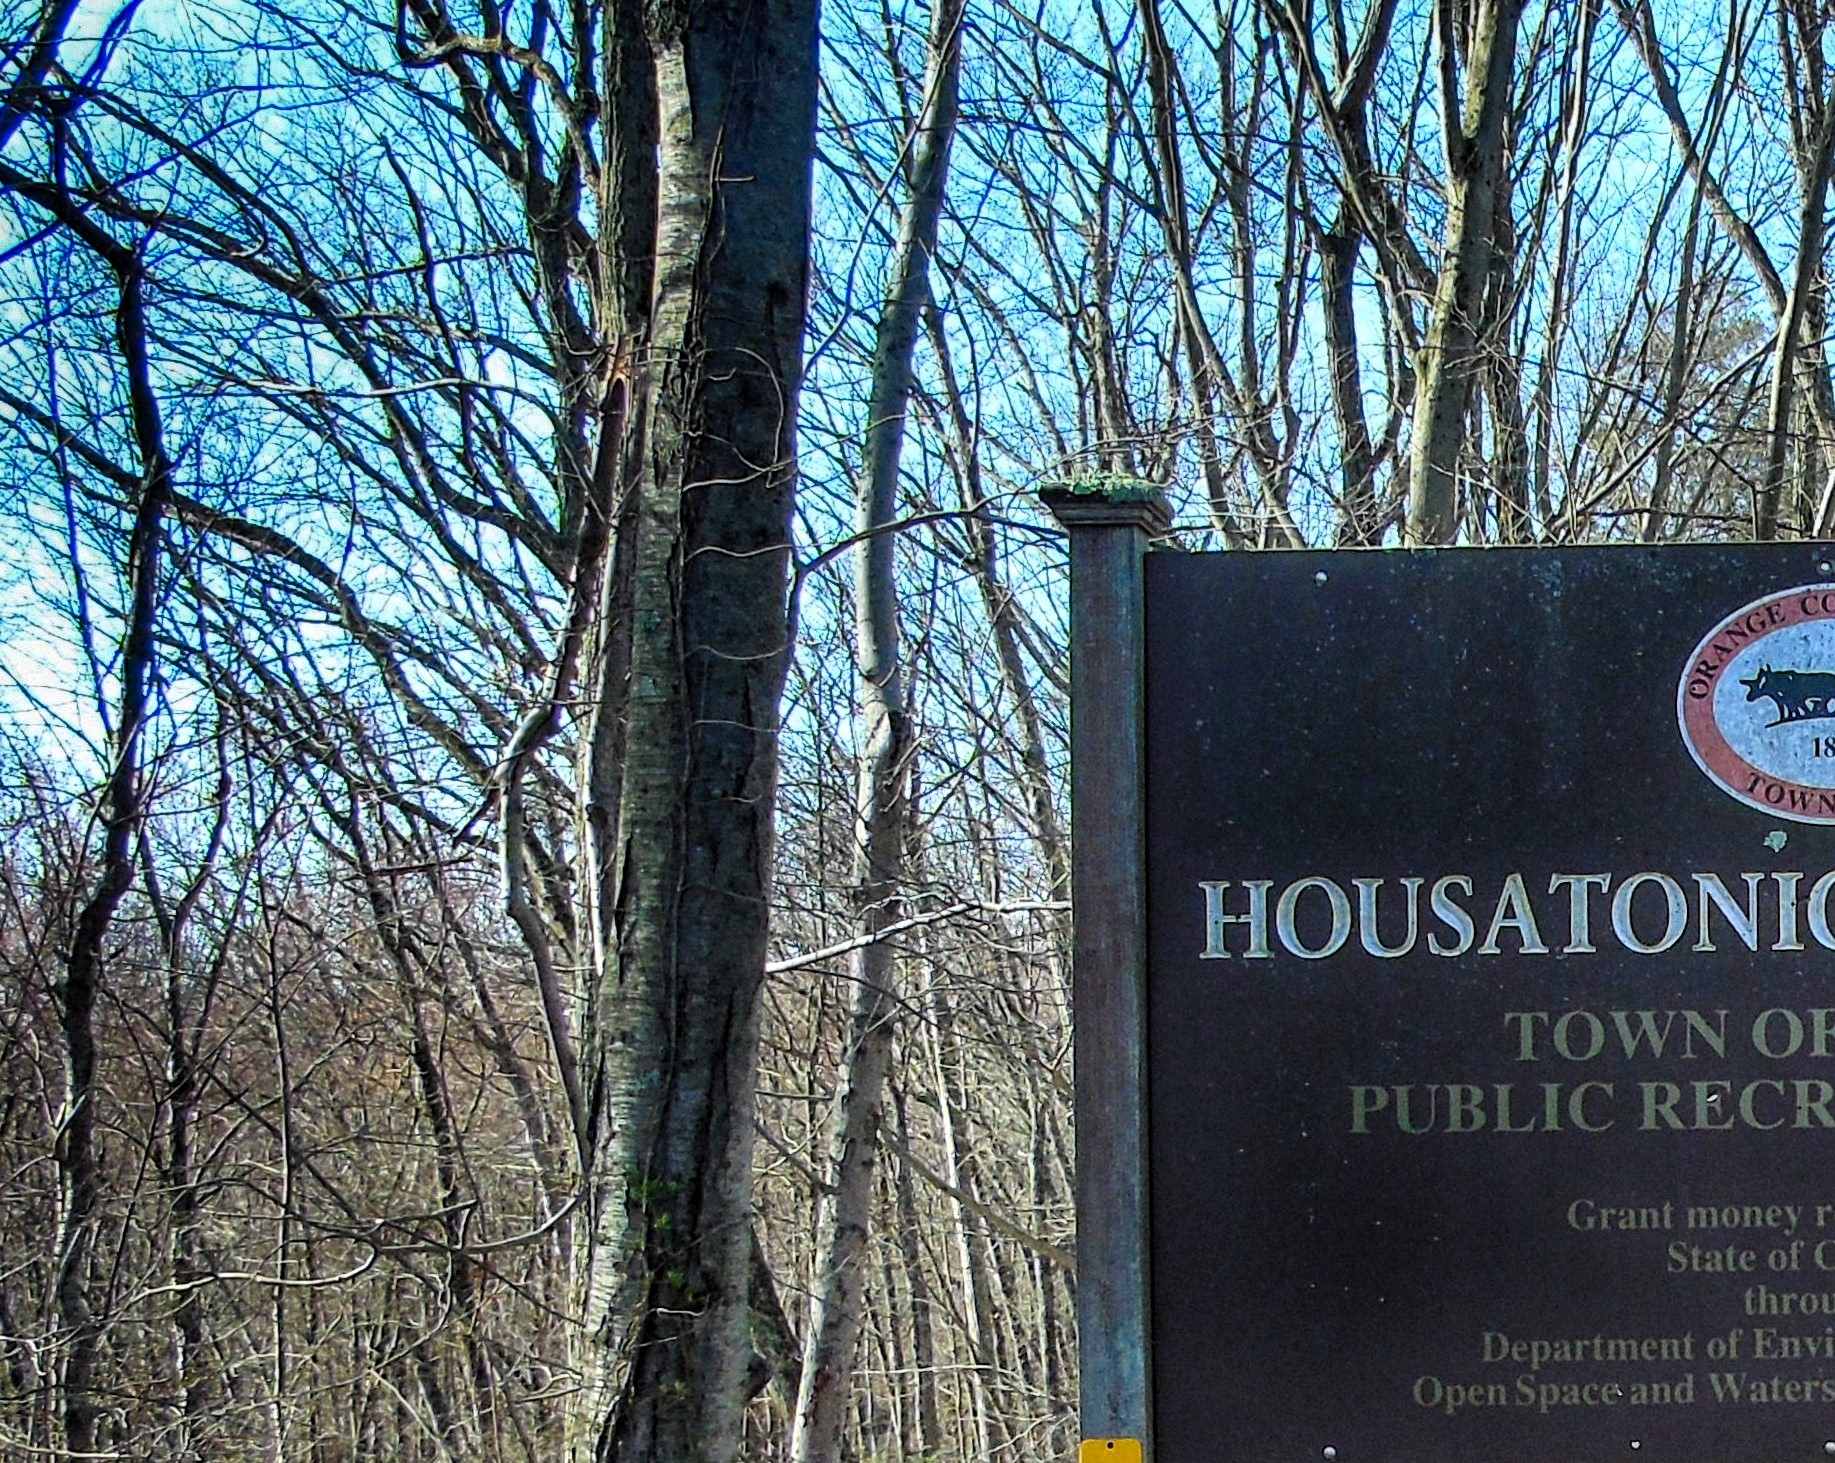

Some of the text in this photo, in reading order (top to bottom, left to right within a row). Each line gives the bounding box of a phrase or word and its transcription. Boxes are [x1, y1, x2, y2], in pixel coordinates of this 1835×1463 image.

[1688, 602, 1787, 701] ORANGE
[1504, 1009, 1730, 1062] TOWN
[1348, 1082, 1615, 1135] PUBLIC
[1567, 1199, 1675, 1232] Grant
[1686, 1203, 1800, 1236] money
[1667, 1240, 1758, 1274] State
[1767, 1239, 1806, 1273] of
[1481, 1330, 1696, 1371] Department
[1706, 1328, 1745, 1361] of
[1412, 1375, 1507, 1415] Open
[1515, 1372, 1620, 1414] Space
[1629, 1371, 1696, 1406] and
